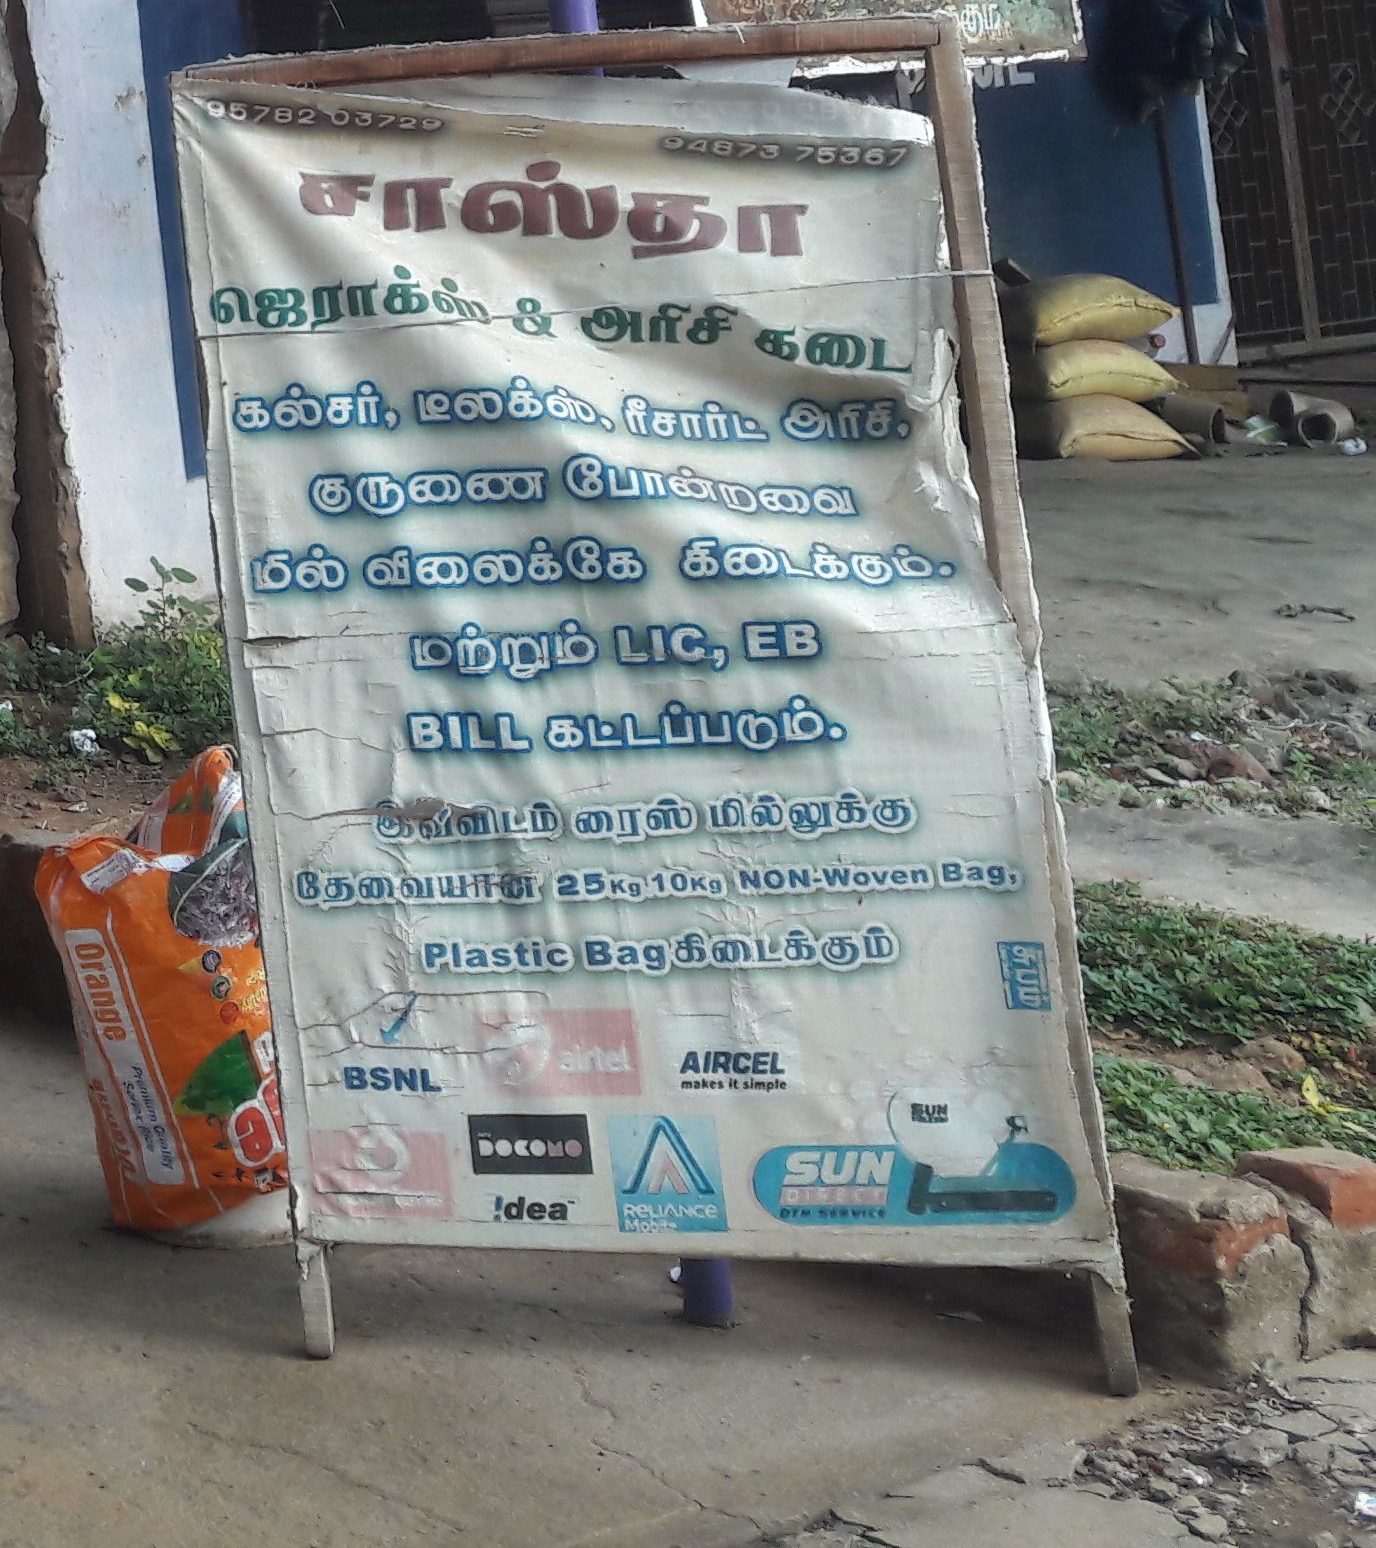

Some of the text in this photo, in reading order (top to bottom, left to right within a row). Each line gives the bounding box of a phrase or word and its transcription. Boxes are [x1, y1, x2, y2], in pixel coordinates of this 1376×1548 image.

[206, 98, 445, 132] 95782 03729
[662, 135, 911, 169] 94873 75367
[299, 159, 810, 260] சாஸ்தா
[512, 297, 558, 339] &
[580, 302, 738, 345] அரிசி
[754, 325, 913, 374] கடை
[409, 618, 599, 682] மற்றும்
[742, 620, 824, 662] EB
[407, 711, 533, 753] BILL
[423, 941, 571, 970] Plastic
[73, 941, 128, 1043] Orange
[343, 1065, 443, 1093] BSNL
[679, 1050, 787, 1076] AIRCEL
[680, 1081, 725, 1091] makes
[742, 1078, 788, 1093] simple
[477, 1138, 583, 1159] DOCOMO
[782, 1150, 897, 1186] SUN
[622, 1202, 719, 1219] RELIANCE
